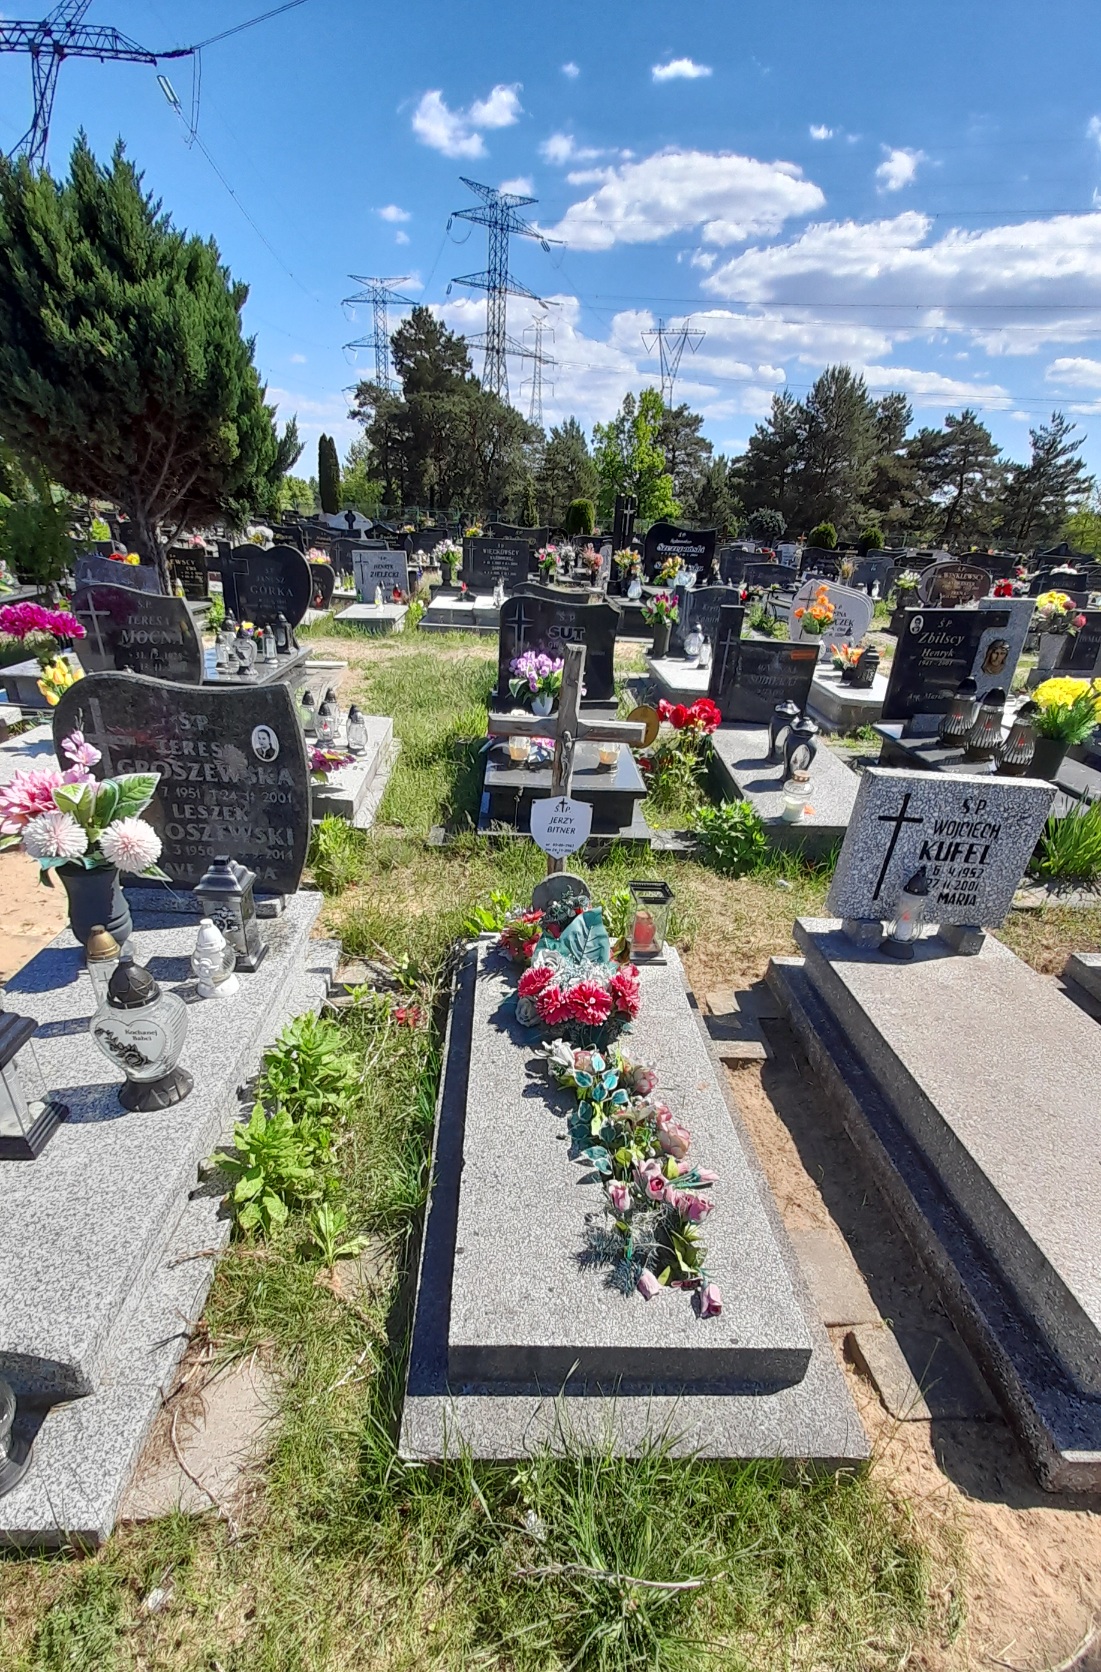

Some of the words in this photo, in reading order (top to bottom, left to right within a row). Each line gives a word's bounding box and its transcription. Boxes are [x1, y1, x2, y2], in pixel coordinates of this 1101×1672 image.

[547, 625, 586, 642] SUT
[918, 631, 965, 647] Zbilscy
[921, 647, 954, 660] Henryk
[154, 739, 224, 758] TERES
[172, 803, 249, 822] LESZEK
[548, 816, 575, 825] JERZY
[165, 822, 295, 847] OSZEWSKI
[546, 826, 576, 835] BITNER
[933, 819, 1002, 841] WOJCIECH
[918, 840, 991, 866] KUFEL
[936, 892, 978, 907] MARIA
[124, 1028, 158, 1037] Kochanej
